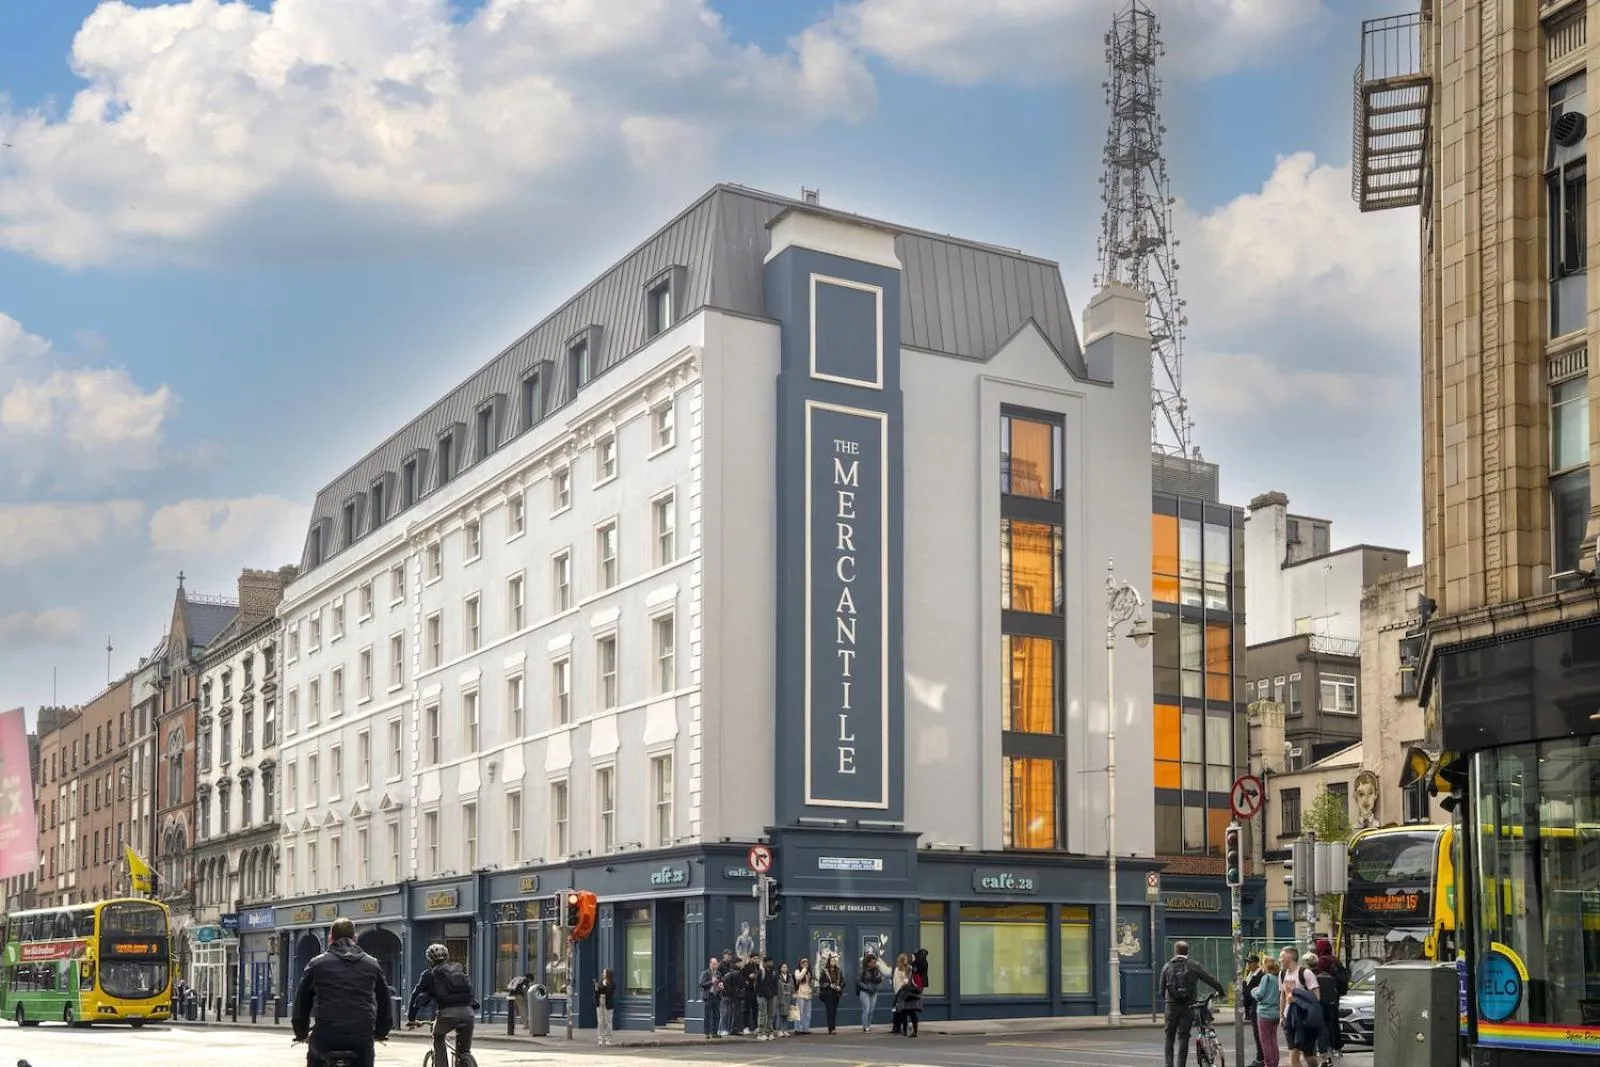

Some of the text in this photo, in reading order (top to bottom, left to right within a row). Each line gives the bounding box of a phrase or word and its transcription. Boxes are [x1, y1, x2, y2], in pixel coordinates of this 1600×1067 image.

[833, 439, 860, 455] THE
[833, 458, 860, 774] MERCANTILE
[1406, 895, 1418, 909] 15
